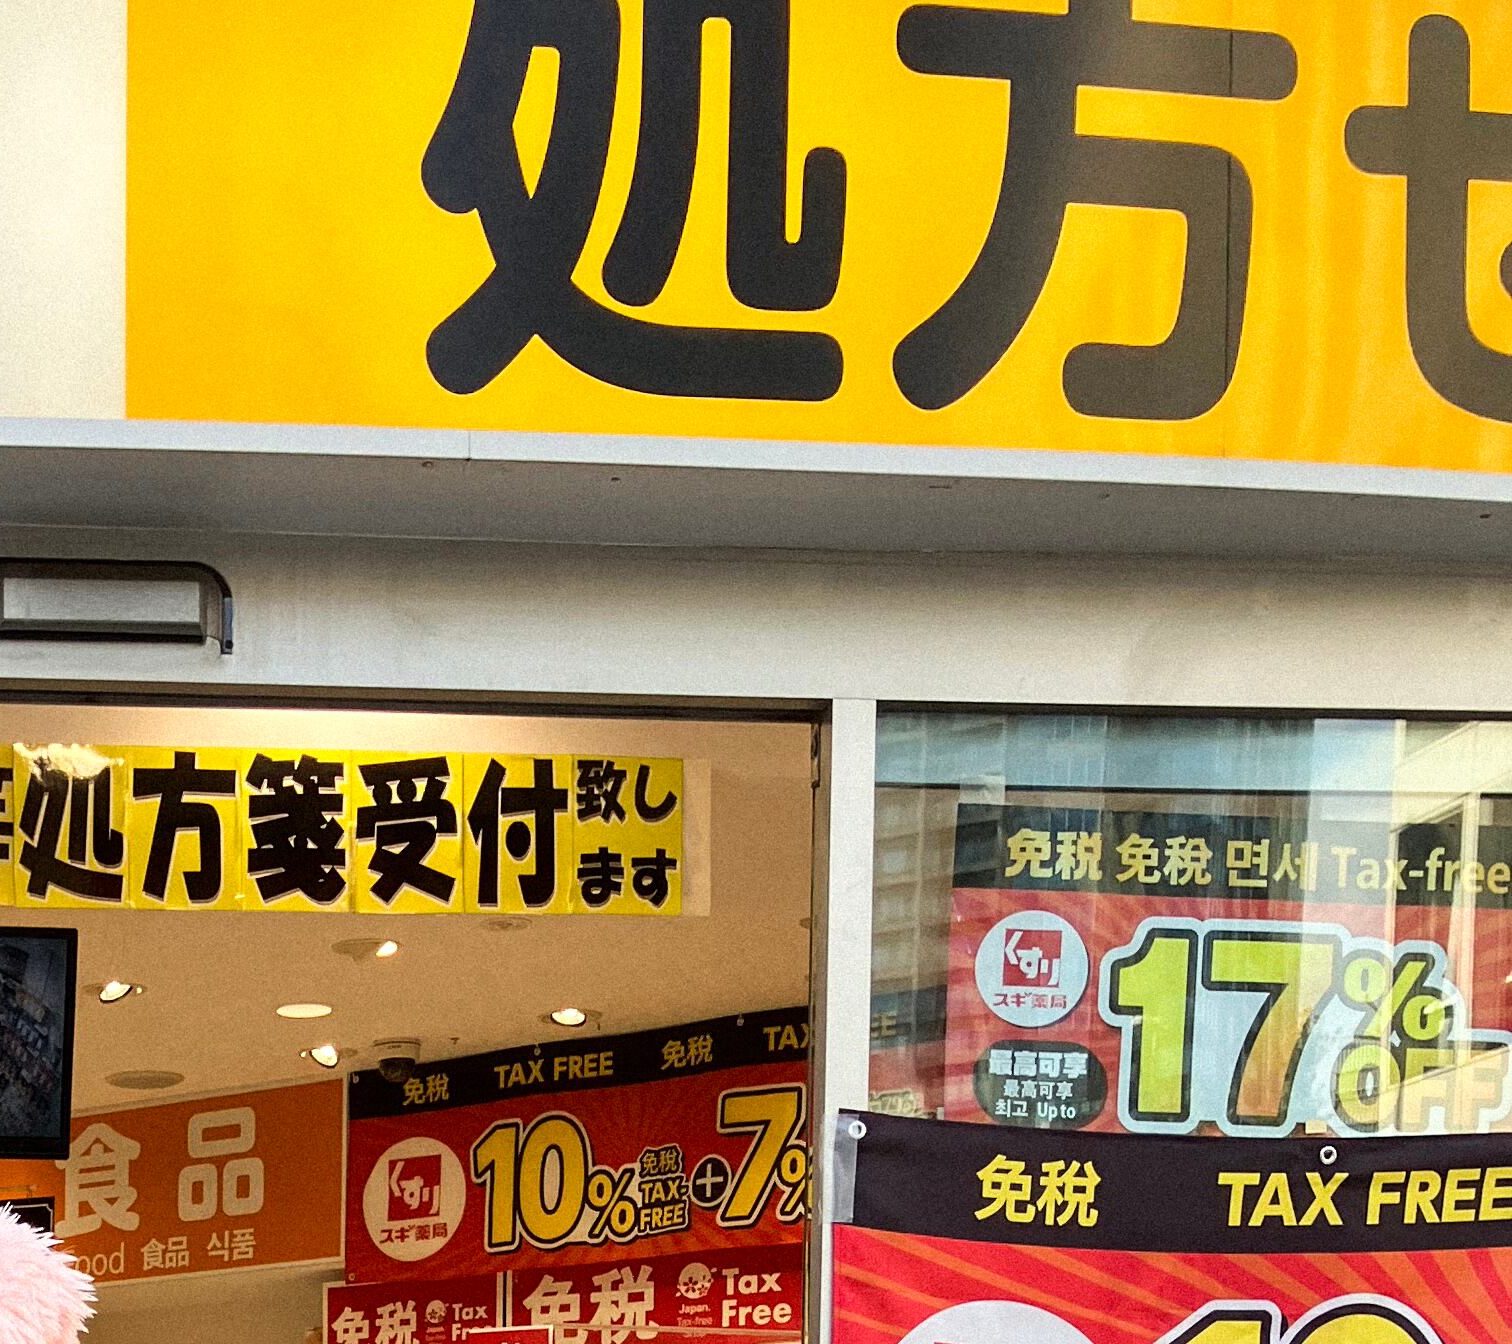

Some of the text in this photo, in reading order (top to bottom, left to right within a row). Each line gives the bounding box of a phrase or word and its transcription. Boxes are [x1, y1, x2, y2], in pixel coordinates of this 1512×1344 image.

[1227, 838, 1317, 891] 면세
[1330, 846, 1511, 895] Tax-free
[1005, 931, 1060, 986] くすり
[992, 992, 1067, 1009] スギ薬局
[1115, 930, 1446, 1120] 17%
[495, 1058, 546, 1089] TAX
[552, 1051, 614, 1081] FREE
[1338, 1043, 1501, 1127] OFF
[1037, 1101, 1058, 1121] Up
[1060, 1103, 1077, 1119] to
[55, 1107, 264, 1235] 食品
[474, 1116, 636, 1248] 10%
[1219, 1171, 1349, 1226] TAX
[1366, 1166, 1512, 1225] FREE
[379, 1221, 449, 1246] スギ薬局
[640, 1203, 685, 1230] FREE
[74, 1241, 125, 1276] ood
[140, 1236, 190, 1271] 食品
[721, 1267, 783, 1296] Tax
[451, 1302, 489, 1322] Tax
[721, 1298, 793, 1328] Free
